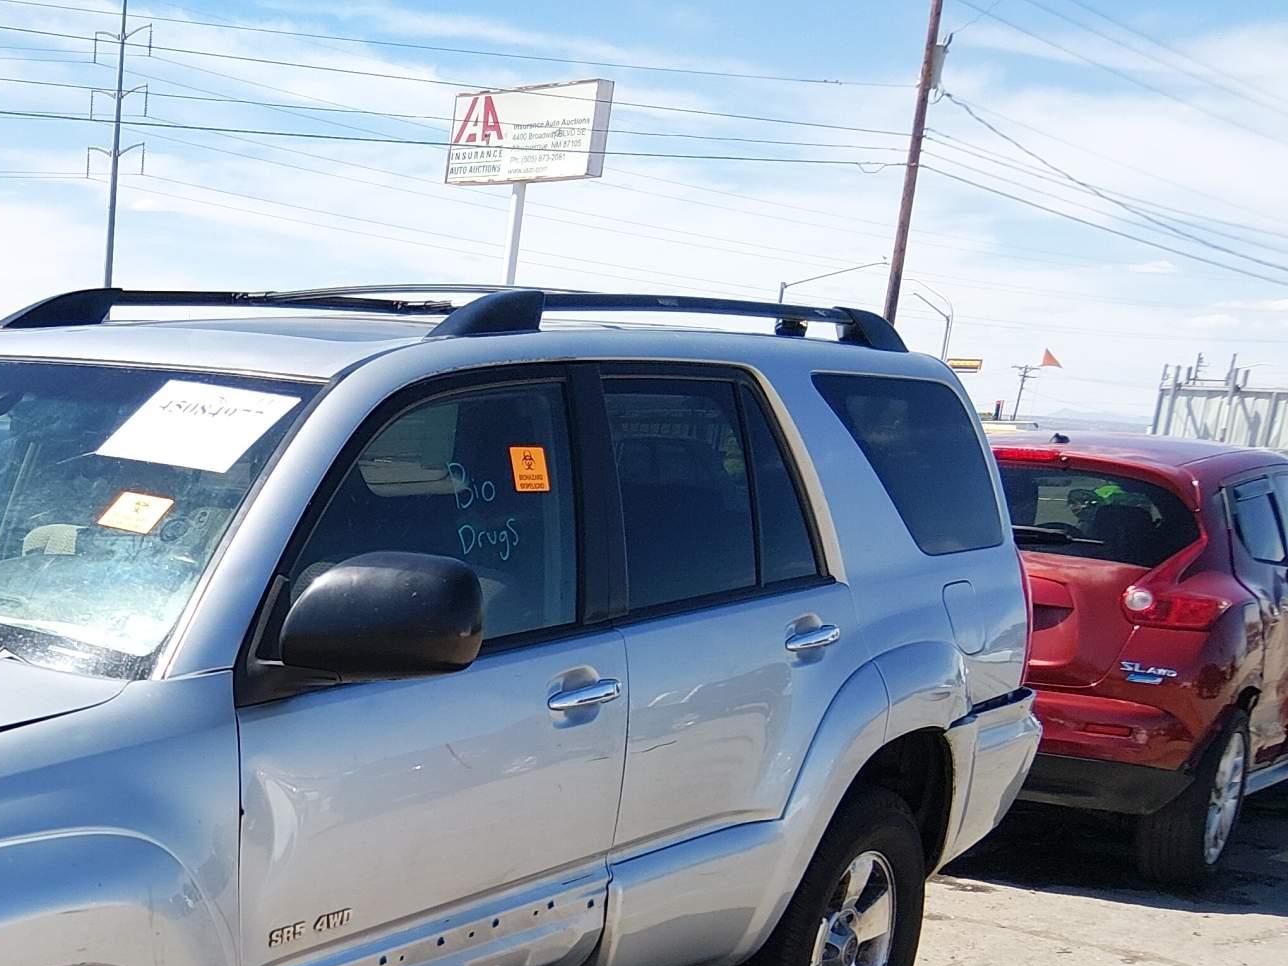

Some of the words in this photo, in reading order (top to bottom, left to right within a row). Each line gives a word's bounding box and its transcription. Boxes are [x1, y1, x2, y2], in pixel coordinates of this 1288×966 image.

[561, 118, 590, 126] Auctions
[576, 128, 587, 136] SE
[451, 150, 504, 161] INSURANCE
[449, 165, 468, 175] AUTO
[468, 164, 502, 174] AUCTIONS
[446, 462, 496, 510] Bio
[458, 518, 520, 562] Drugs
[1120, 661, 1145, 673] SL
[268, 921, 306, 947] SR5
[313, 907, 353, 933] 4WD
